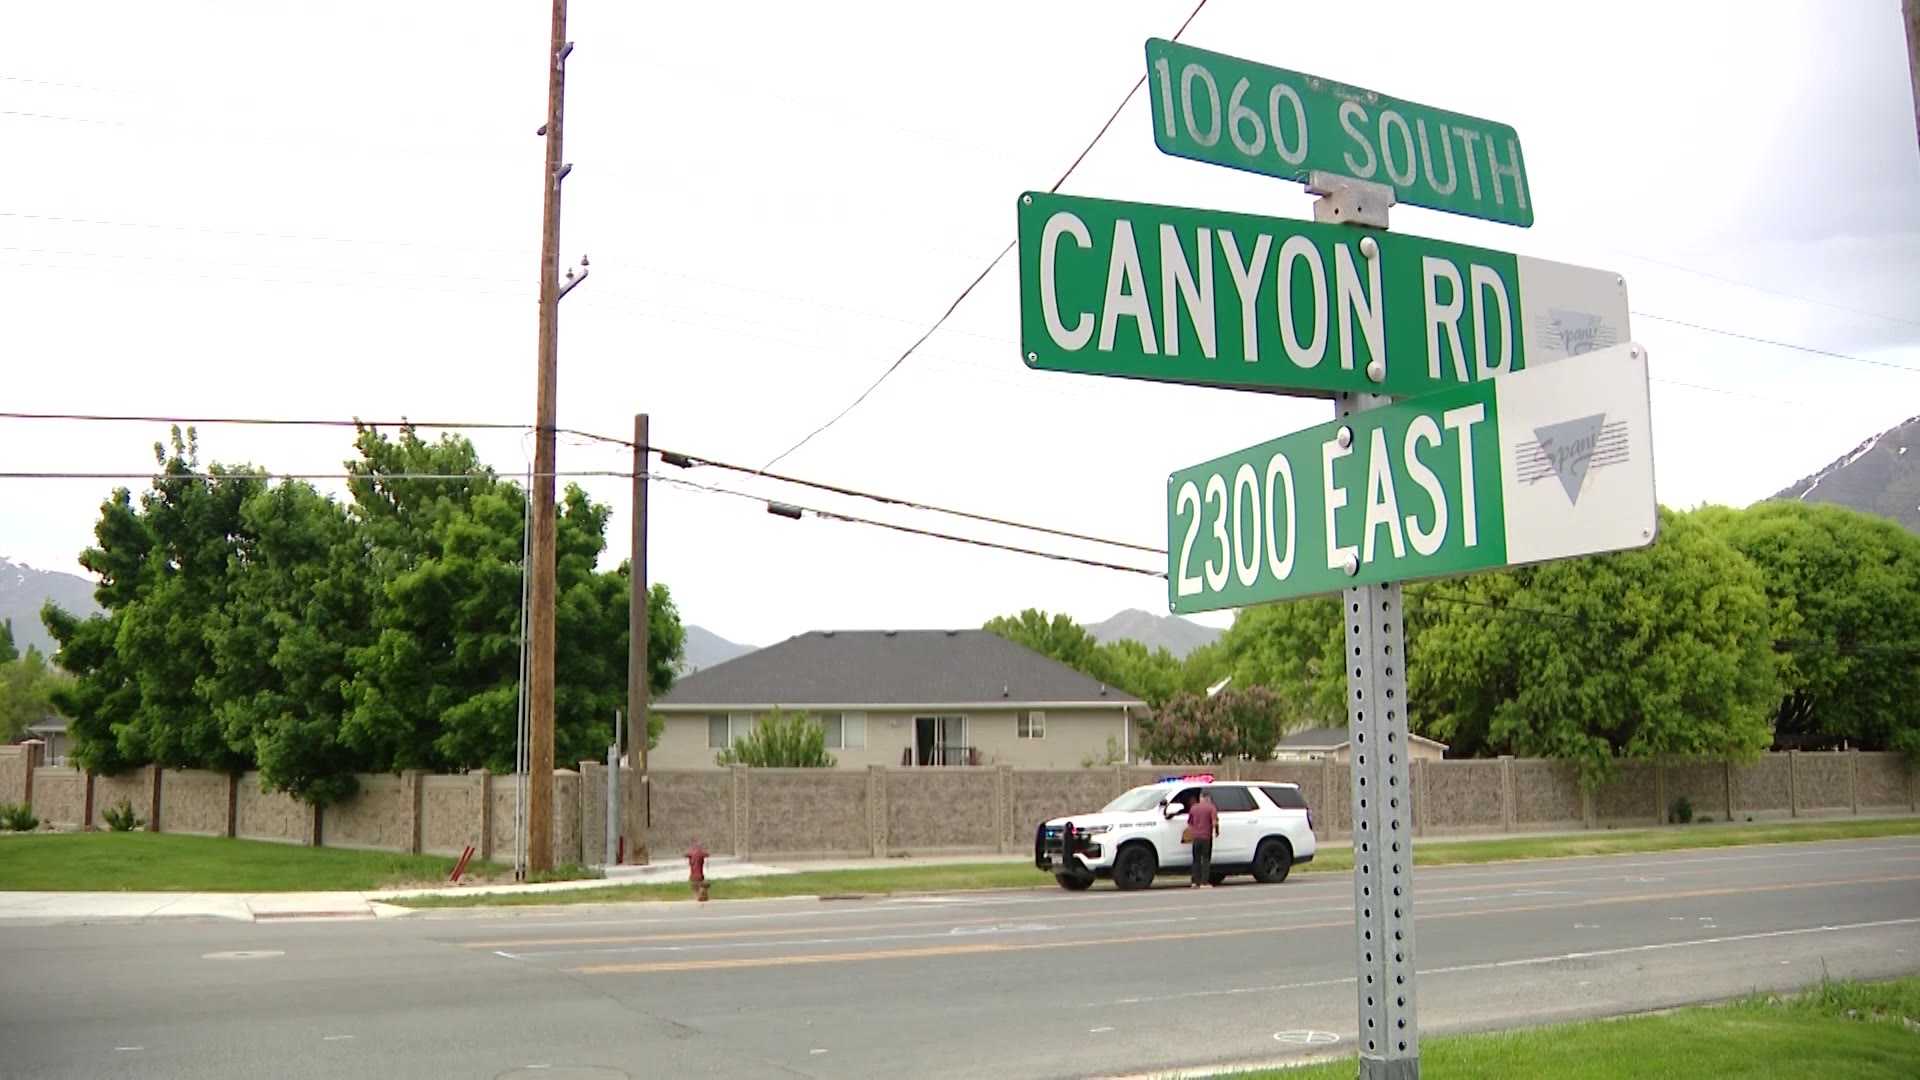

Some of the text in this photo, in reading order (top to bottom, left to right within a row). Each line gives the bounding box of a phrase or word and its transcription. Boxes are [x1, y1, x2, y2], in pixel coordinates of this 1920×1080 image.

[1155, 57, 1527, 209] 1060 SOUTH
[1040, 213, 1514, 382] CANYON RD
[1176, 402, 1486, 597] 2300 EAST
